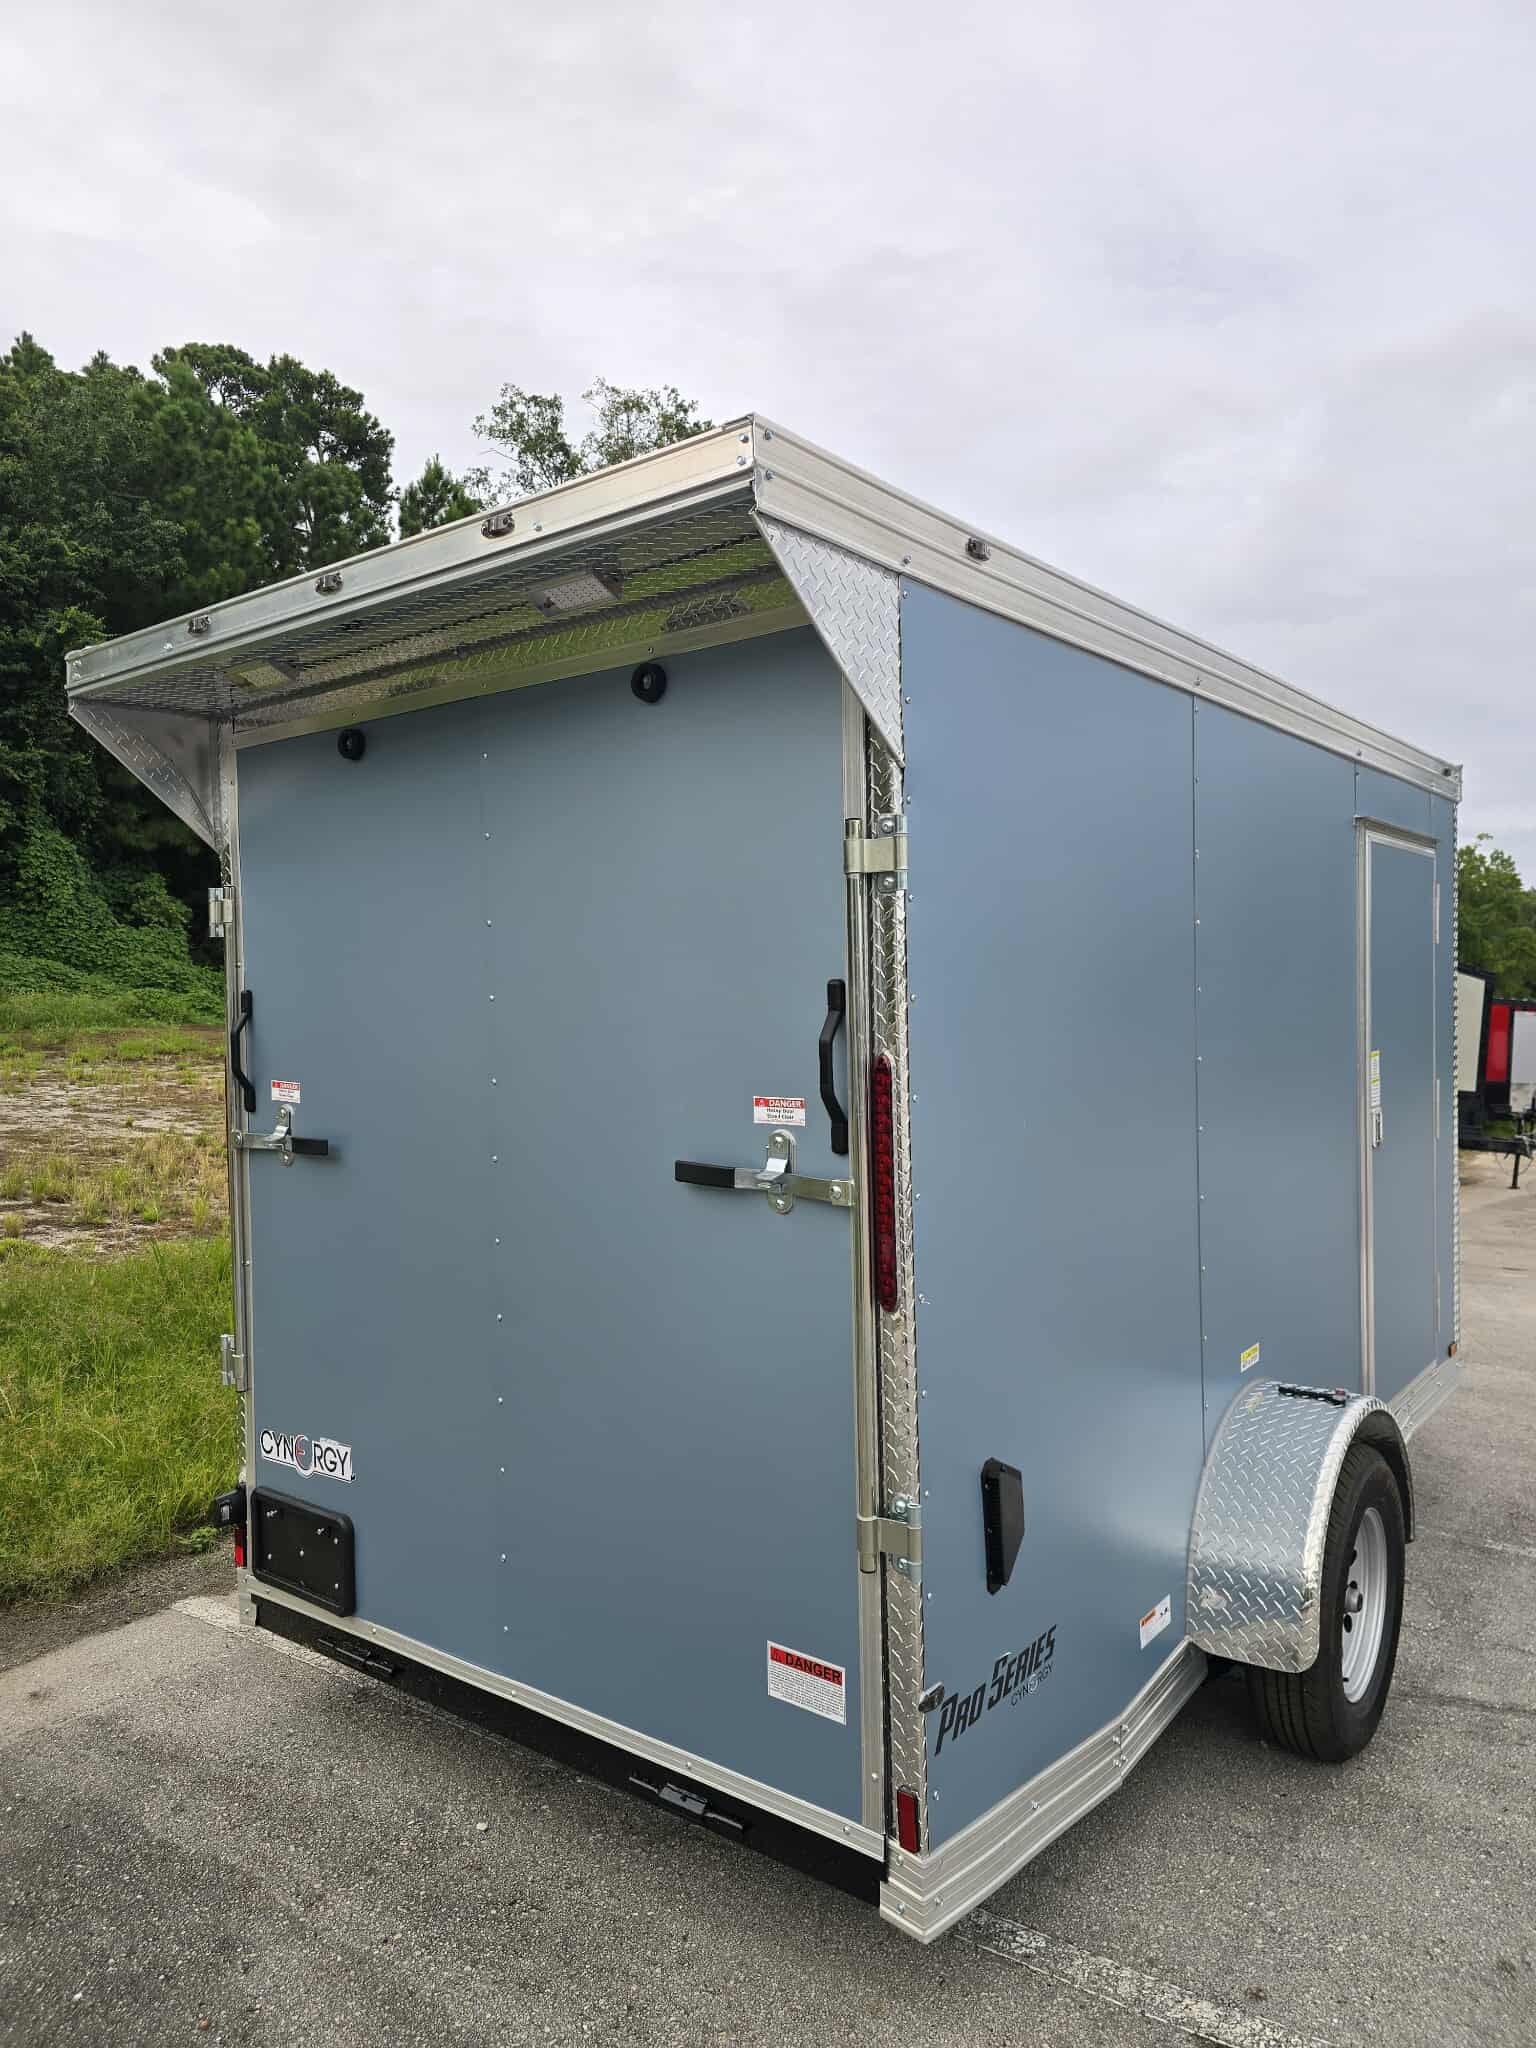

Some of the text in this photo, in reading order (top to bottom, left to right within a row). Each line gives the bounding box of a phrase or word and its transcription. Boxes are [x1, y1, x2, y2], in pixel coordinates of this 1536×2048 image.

[769, 1099, 803, 1108] DANGER
[260, 1430, 349, 1476] CYNERGY
[785, 1652, 842, 1685] DANGER
